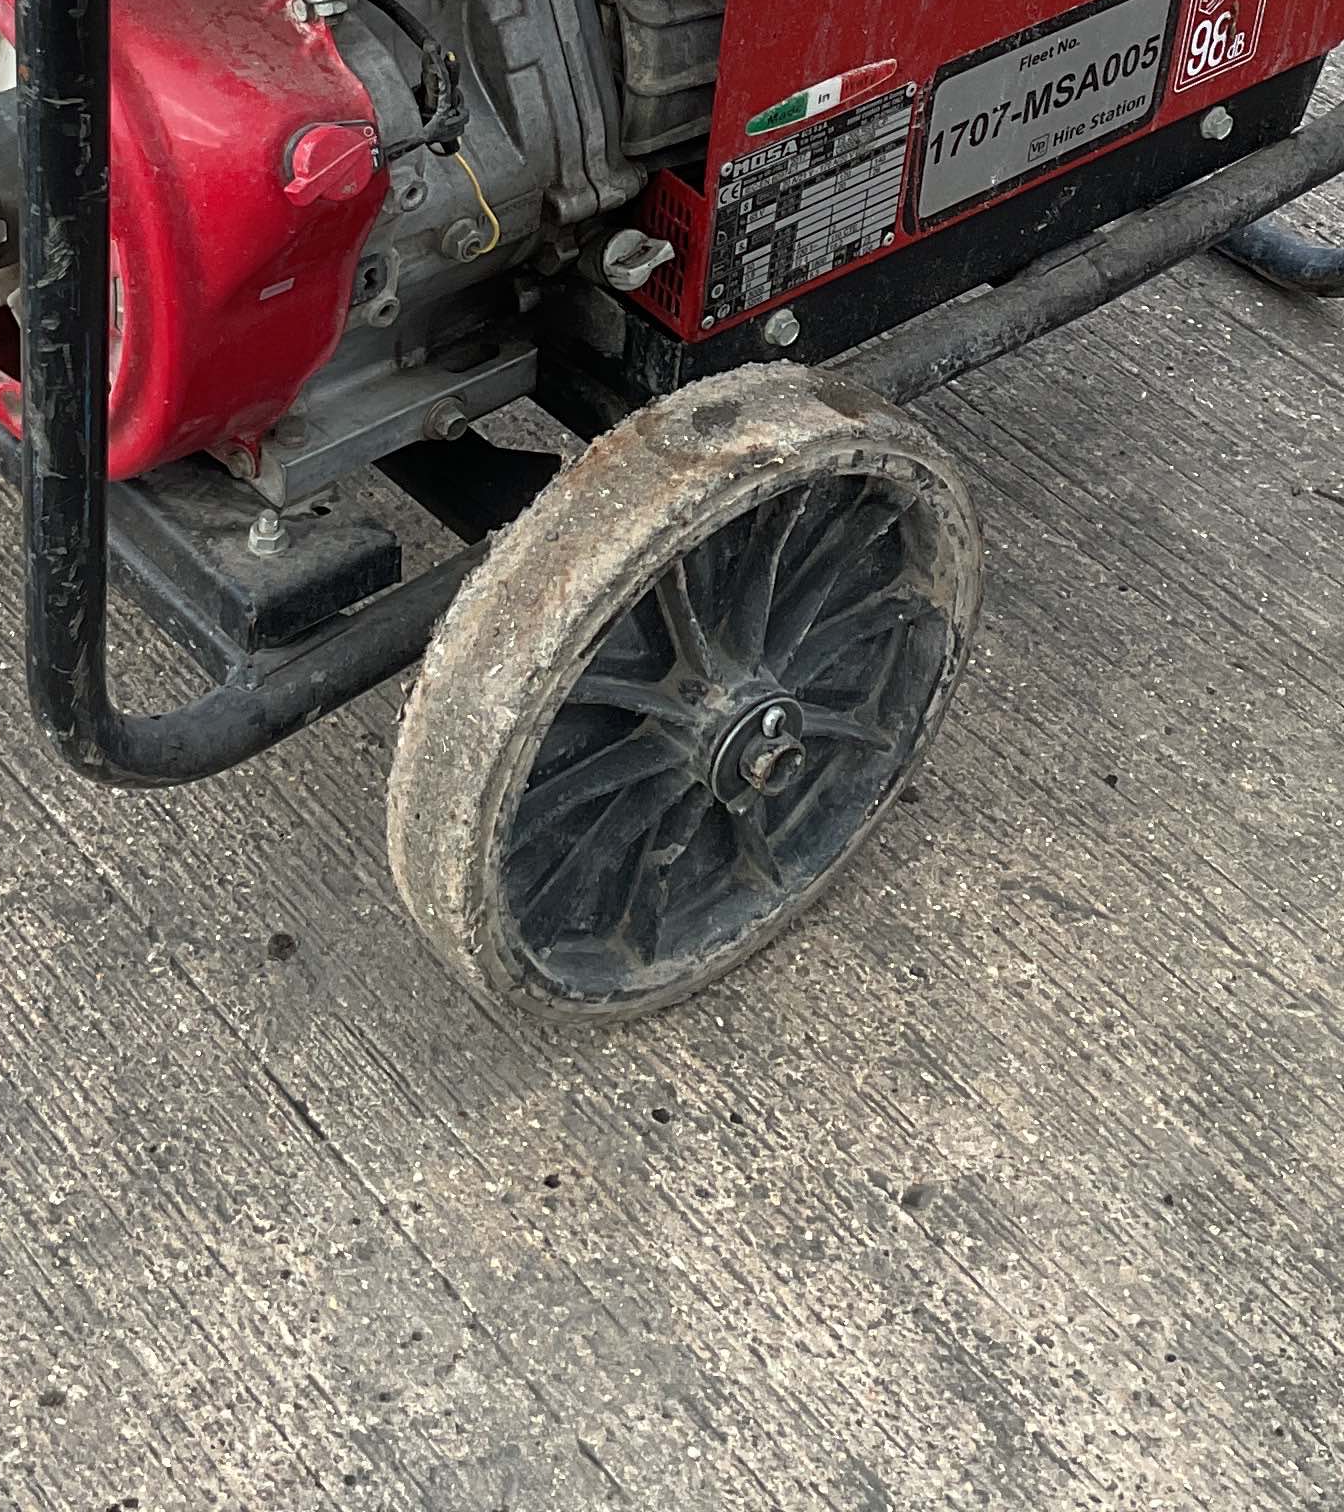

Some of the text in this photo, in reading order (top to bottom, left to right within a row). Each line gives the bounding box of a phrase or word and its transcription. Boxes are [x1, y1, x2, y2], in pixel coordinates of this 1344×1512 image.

[1018, 37, 1081, 72] Fleet No.
[1227, 31, 1245, 59] dB
[929, 34, 1161, 165] 1707-MSA005
[1052, 122, 1086, 147] Hire
[1089, 94, 1147, 129] Station
[733, 139, 799, 178] MOSA
[720, 182, 742, 206] CE
